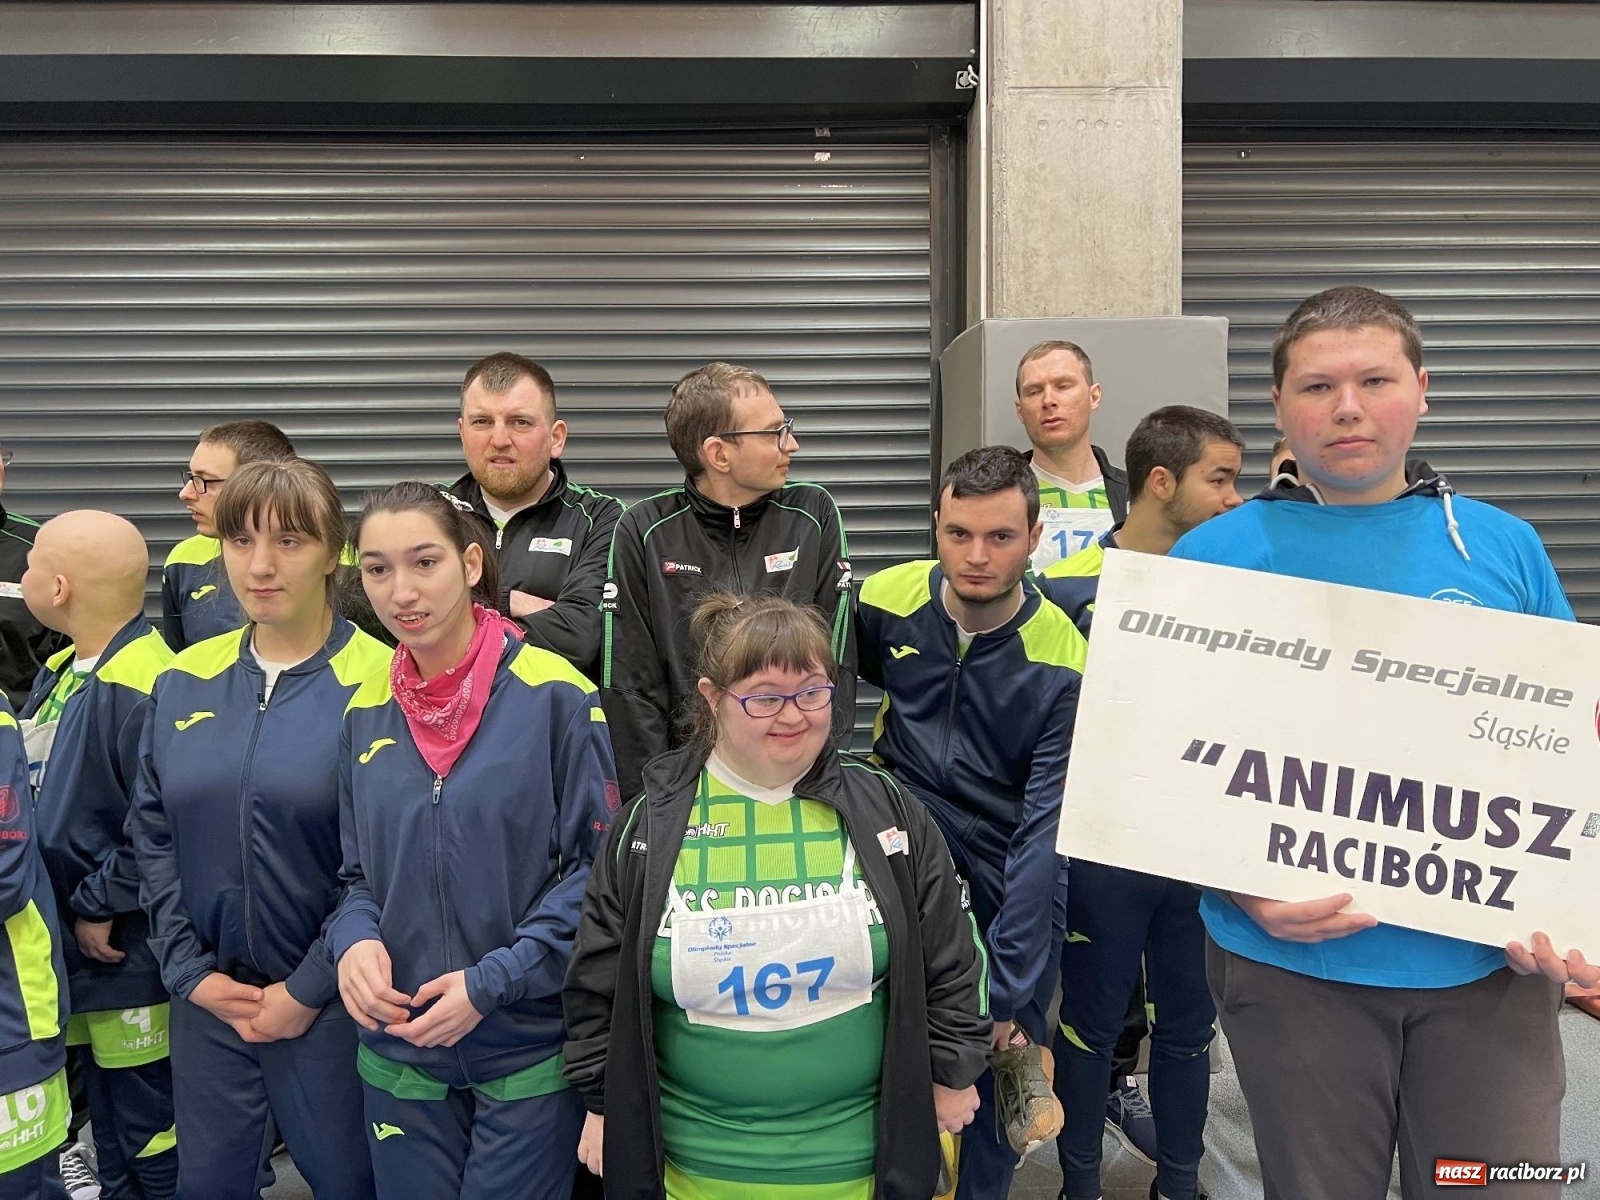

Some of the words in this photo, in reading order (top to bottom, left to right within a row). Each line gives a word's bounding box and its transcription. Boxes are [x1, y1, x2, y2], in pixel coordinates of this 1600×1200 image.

[1051, 529, 1109, 559] 17
[1118, 608, 1333, 672] Olimpiady
[1351, 649, 1575, 708] Specjalne
[1468, 710, 1570, 755] Śląskie
[1266, 822, 1519, 912] RACIBÓRZ
[717, 955, 836, 1016] 167
